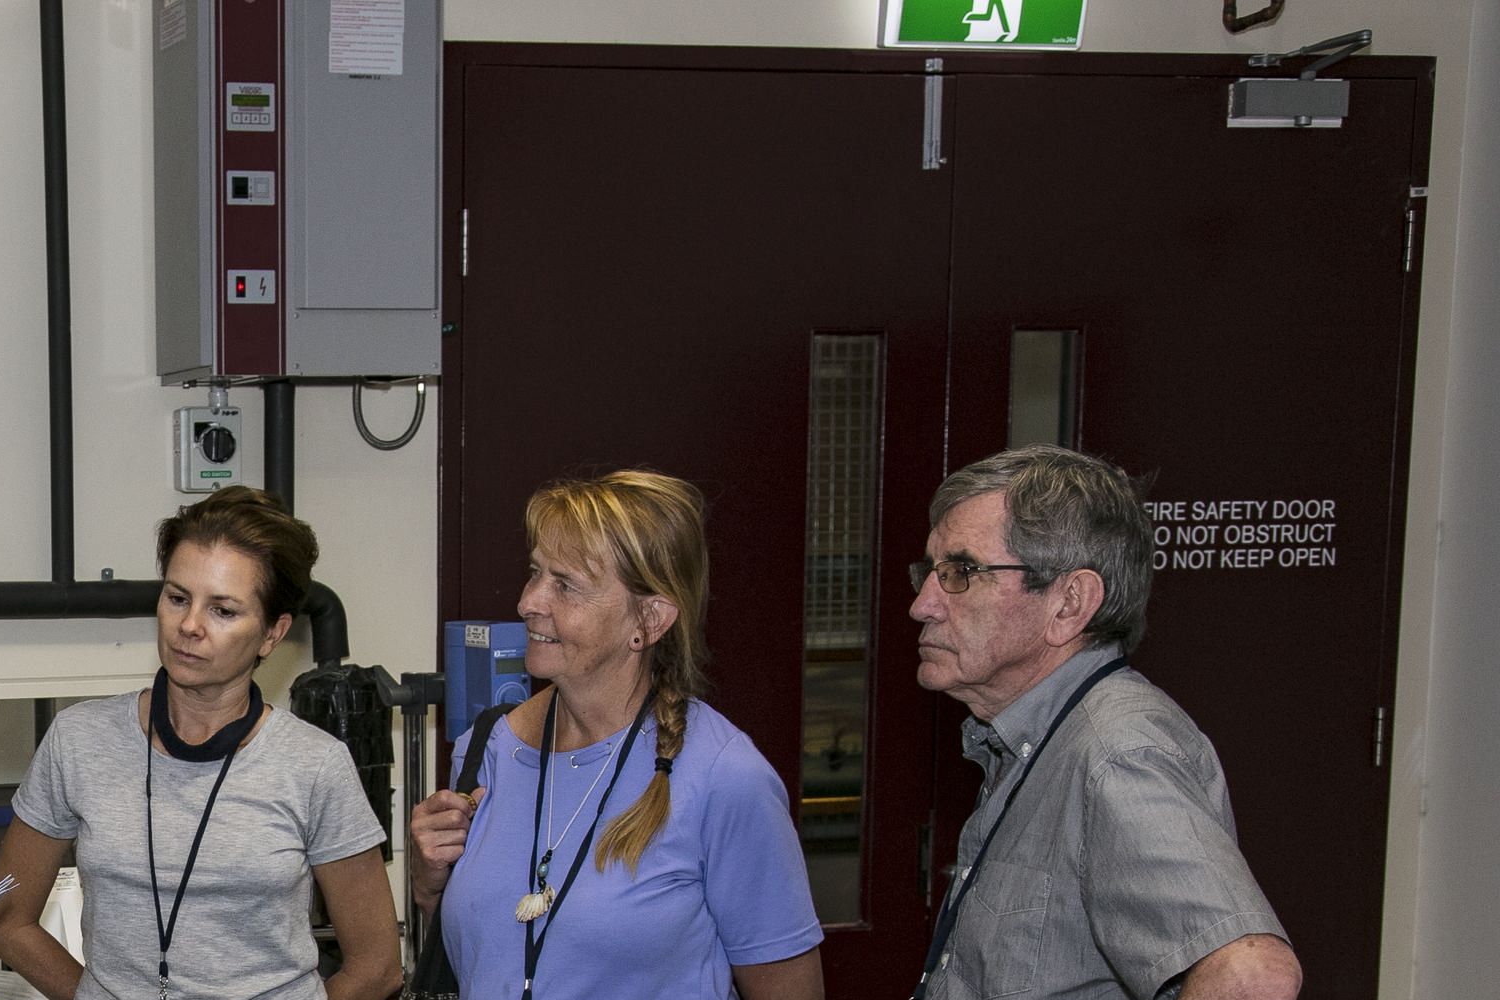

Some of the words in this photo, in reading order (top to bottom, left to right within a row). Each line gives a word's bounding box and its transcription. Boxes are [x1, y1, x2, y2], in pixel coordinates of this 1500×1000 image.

[1191, 500, 1268, 521] SAFETY
[1272, 499, 1336, 519] DOOR
[1175, 524, 1220, 545] NOT
[1223, 523, 1336, 544] OBSTRUCT
[1172, 549, 1217, 569] NOT
[1220, 549, 1274, 568] KEEP
[1278, 547, 1336, 567] OPEN
